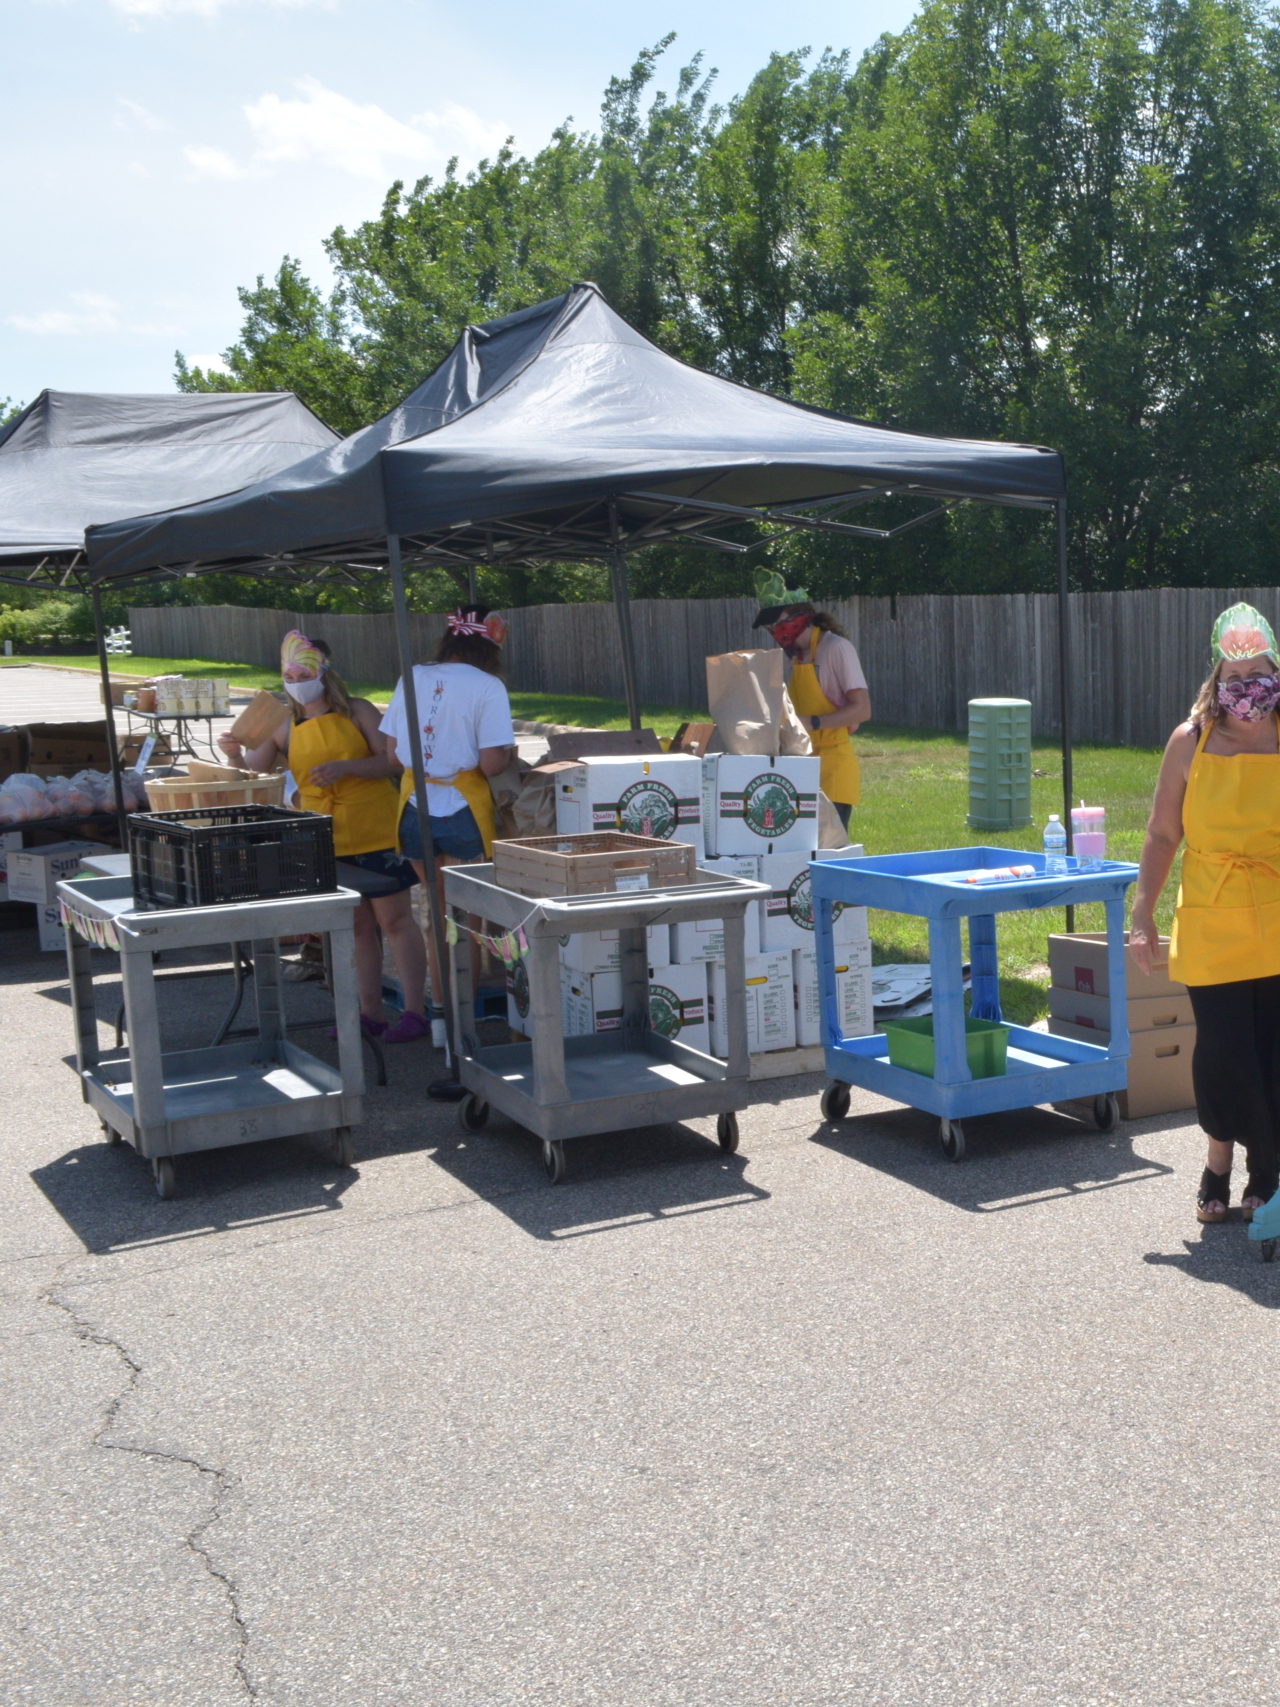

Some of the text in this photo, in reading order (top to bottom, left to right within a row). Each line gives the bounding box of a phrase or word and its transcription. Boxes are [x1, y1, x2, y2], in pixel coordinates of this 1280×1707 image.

[622, 783, 674, 803] FARM FRESH
[747, 775, 794, 794] FARM FRESH
[592, 812, 616, 820] Quality
[747, 818, 794, 836] VEGETABLES
